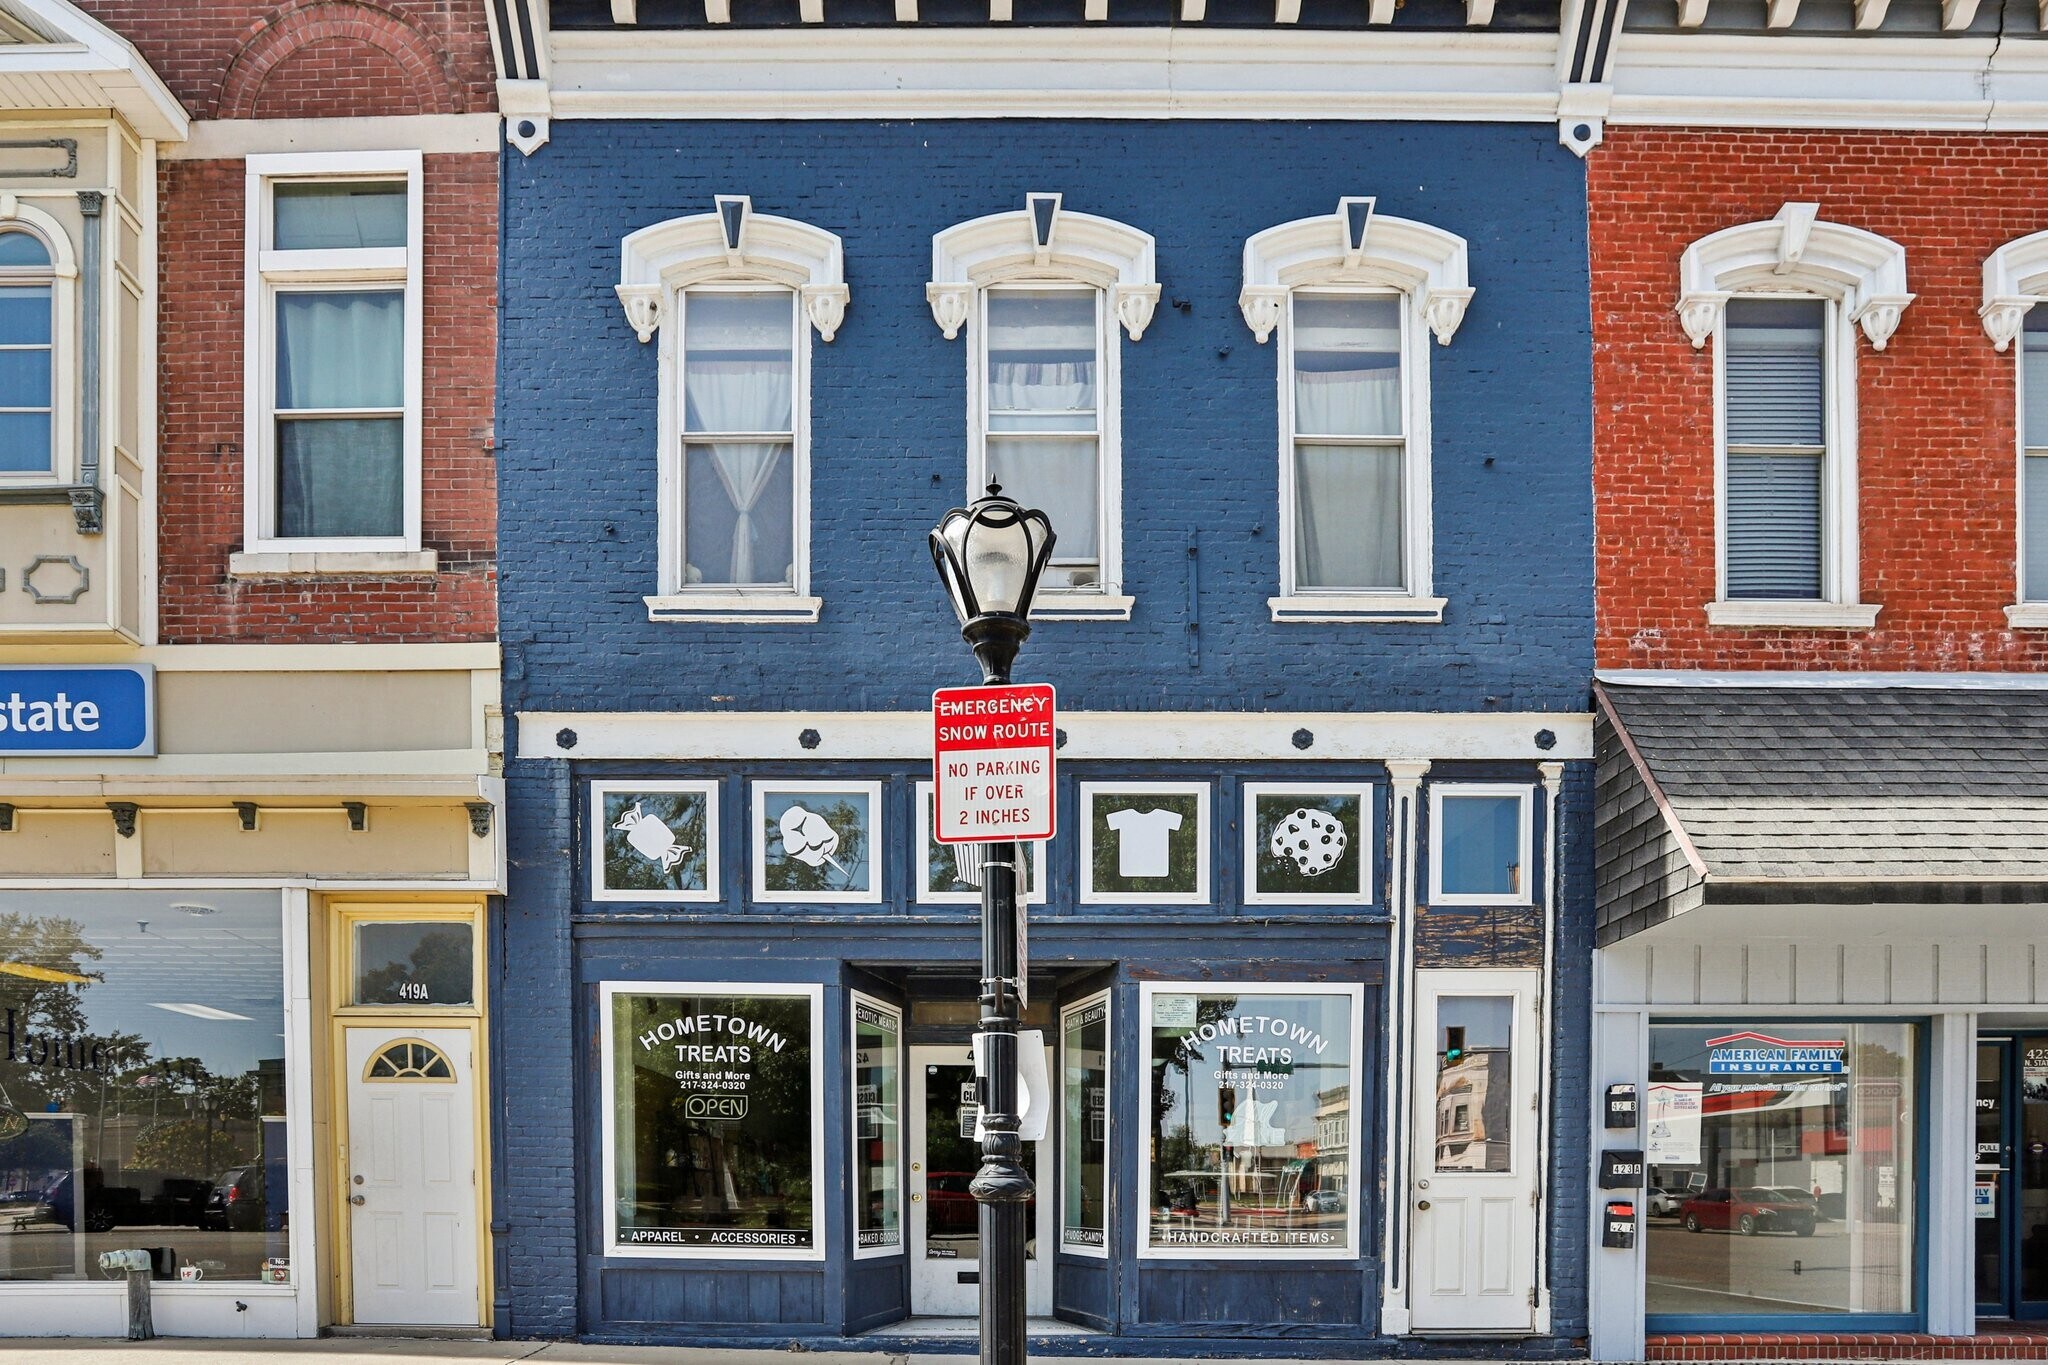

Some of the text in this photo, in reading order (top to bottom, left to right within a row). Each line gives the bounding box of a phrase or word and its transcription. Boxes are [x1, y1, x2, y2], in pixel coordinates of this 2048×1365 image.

[940, 697, 1046, 716] EMERGENCY
[939, 722, 1050, 742] SNOW ROUTE
[949, 760, 1040, 778] NO PARKING
[965, 785, 1023, 801] IF OVER
[959, 808, 1030, 825] 2 INCHES
[399, 983, 429, 1000] 419A
[858, 1007, 896, 1031] EXOTIC MEATS
[1066, 1016, 1080, 1030] BATH
[1084, 1006, 1104, 1023] BEAUTY
[639, 1014, 787, 1054] HOMETOWN
[1180, 1016, 1329, 1055] HOMETOWN
[674, 1045, 751, 1063] TREATS
[1216, 1045, 1292, 1065] TREATS
[1710, 1049, 1843, 1061] AMERICAN FAMILY
[675, 1070, 750, 1080] Gifts and More
[1214, 1070, 1289, 1080] Gifts and More
[1721, 1063, 1832, 1072] INSURANCE
[680, 1081, 746, 1090] 217-324-0320
[1219, 1081, 1284, 1090] 217-324-0320
[689, 1098, 743, 1116] OPEN
[631, 1231, 796, 1245] APPAREL ACCESSORIES
[860, 1232, 898, 1244] BAKED GOODS
[1168, 1232, 1329, 1243] HANDCRAFTED ITEMS
